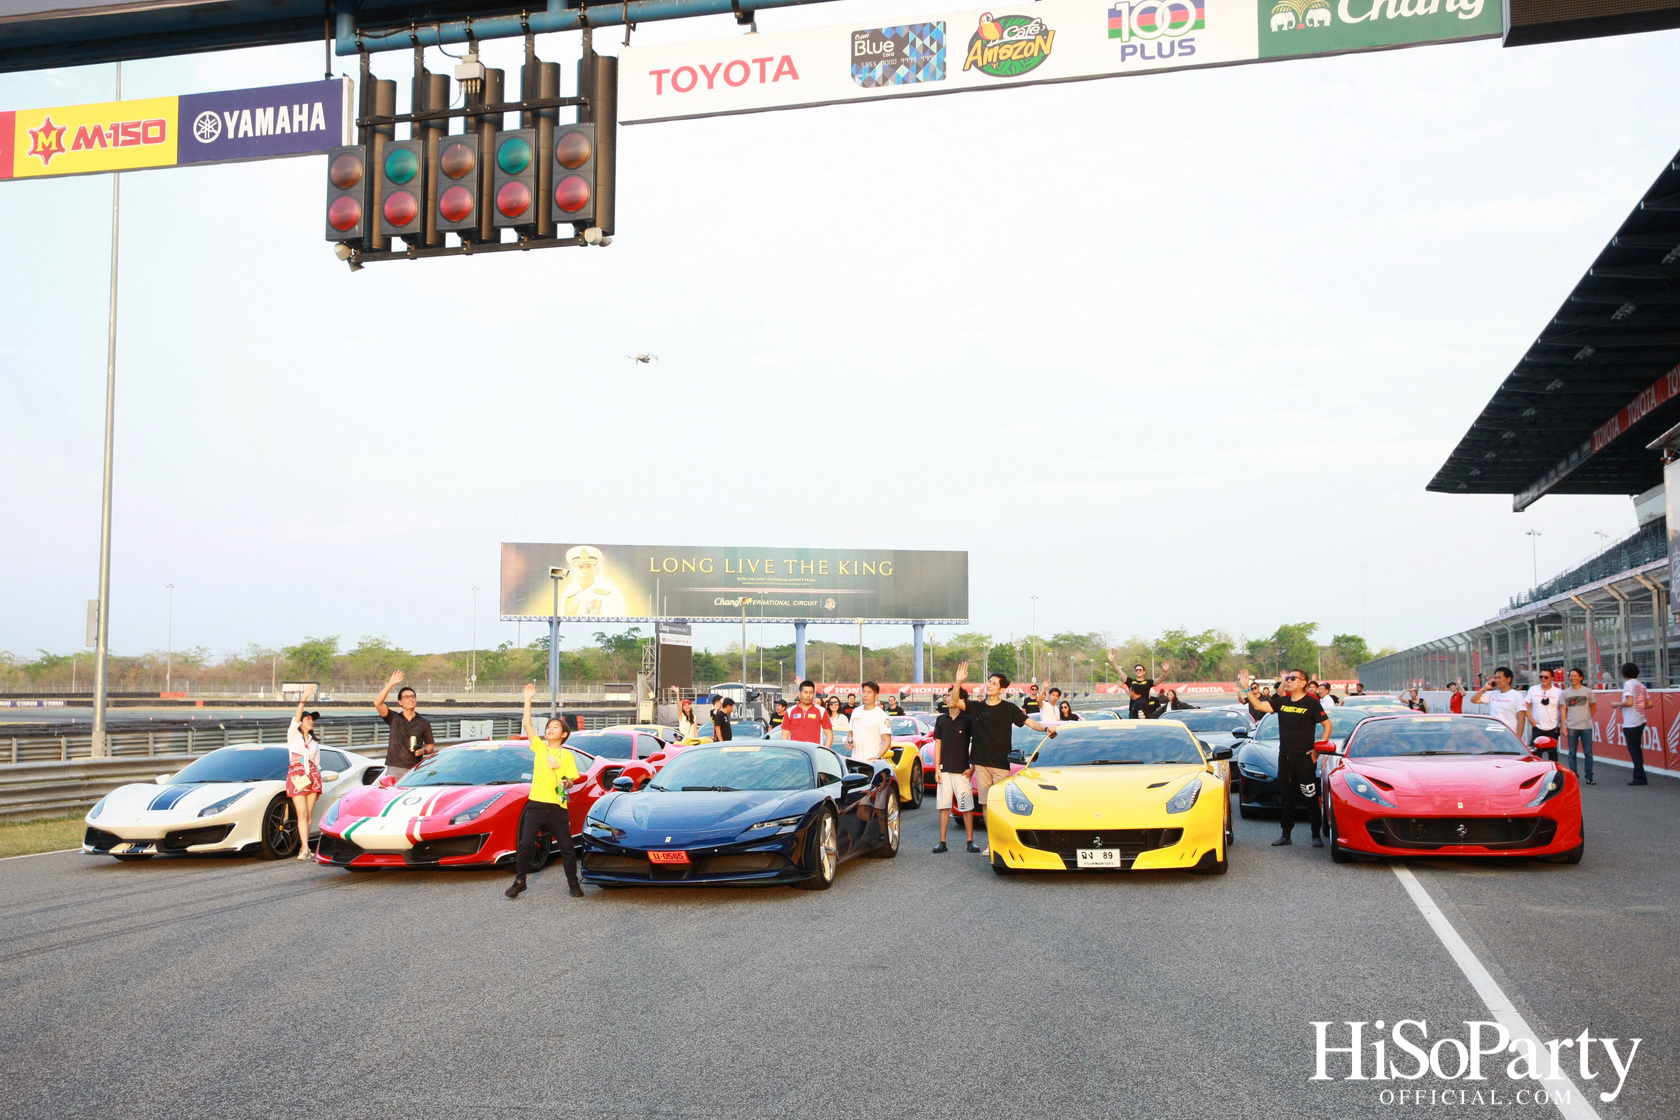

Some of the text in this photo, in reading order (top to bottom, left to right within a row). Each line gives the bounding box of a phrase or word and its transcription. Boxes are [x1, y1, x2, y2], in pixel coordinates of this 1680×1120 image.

[1115, 0, 1197, 42] 100
[854, 39, 895, 56] Blue
[1120, 37, 1196, 62] PLUS
[649, 54, 800, 96] TOYOTA
[71, 118, 167, 151] M-150
[223, 102, 327, 139] YAMAHA
[1626, 386, 1657, 426] TOYOTA
[1593, 414, 1620, 450] TOYOTA
[649, 557, 895, 576] LONG LIVE THE KING
[714, 597, 740, 608] Chang
[1616, 723, 1662, 752] HDA
[1102, 851, 1114, 860] 89
